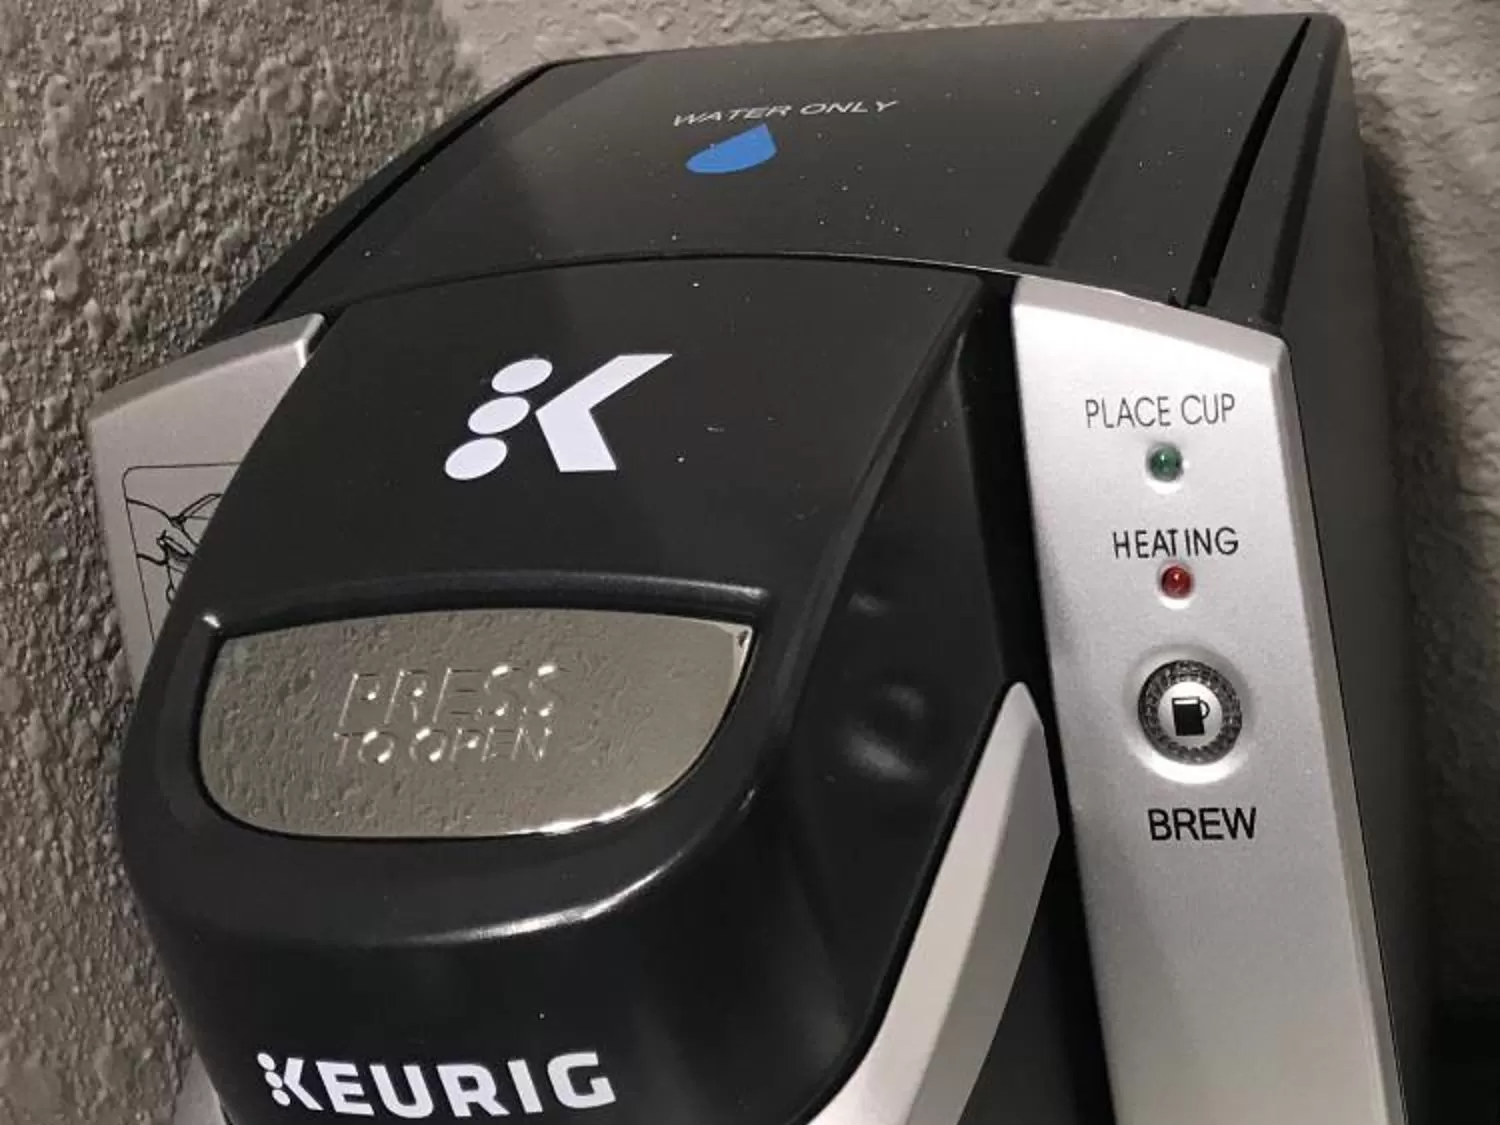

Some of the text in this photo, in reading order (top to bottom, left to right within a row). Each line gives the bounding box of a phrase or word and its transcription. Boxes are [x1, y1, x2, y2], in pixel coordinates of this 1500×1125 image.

[673, 100, 899, 126] WATER ONLY
[1086, 393, 1235, 428] PLACE CUP
[1113, 527, 1239, 559] HEATING
[338, 664, 569, 725] PRESS
[334, 726, 553, 765] TO OPEN
[1147, 806, 1257, 841] BREW
[257, 1051, 616, 1119] KEURIG
